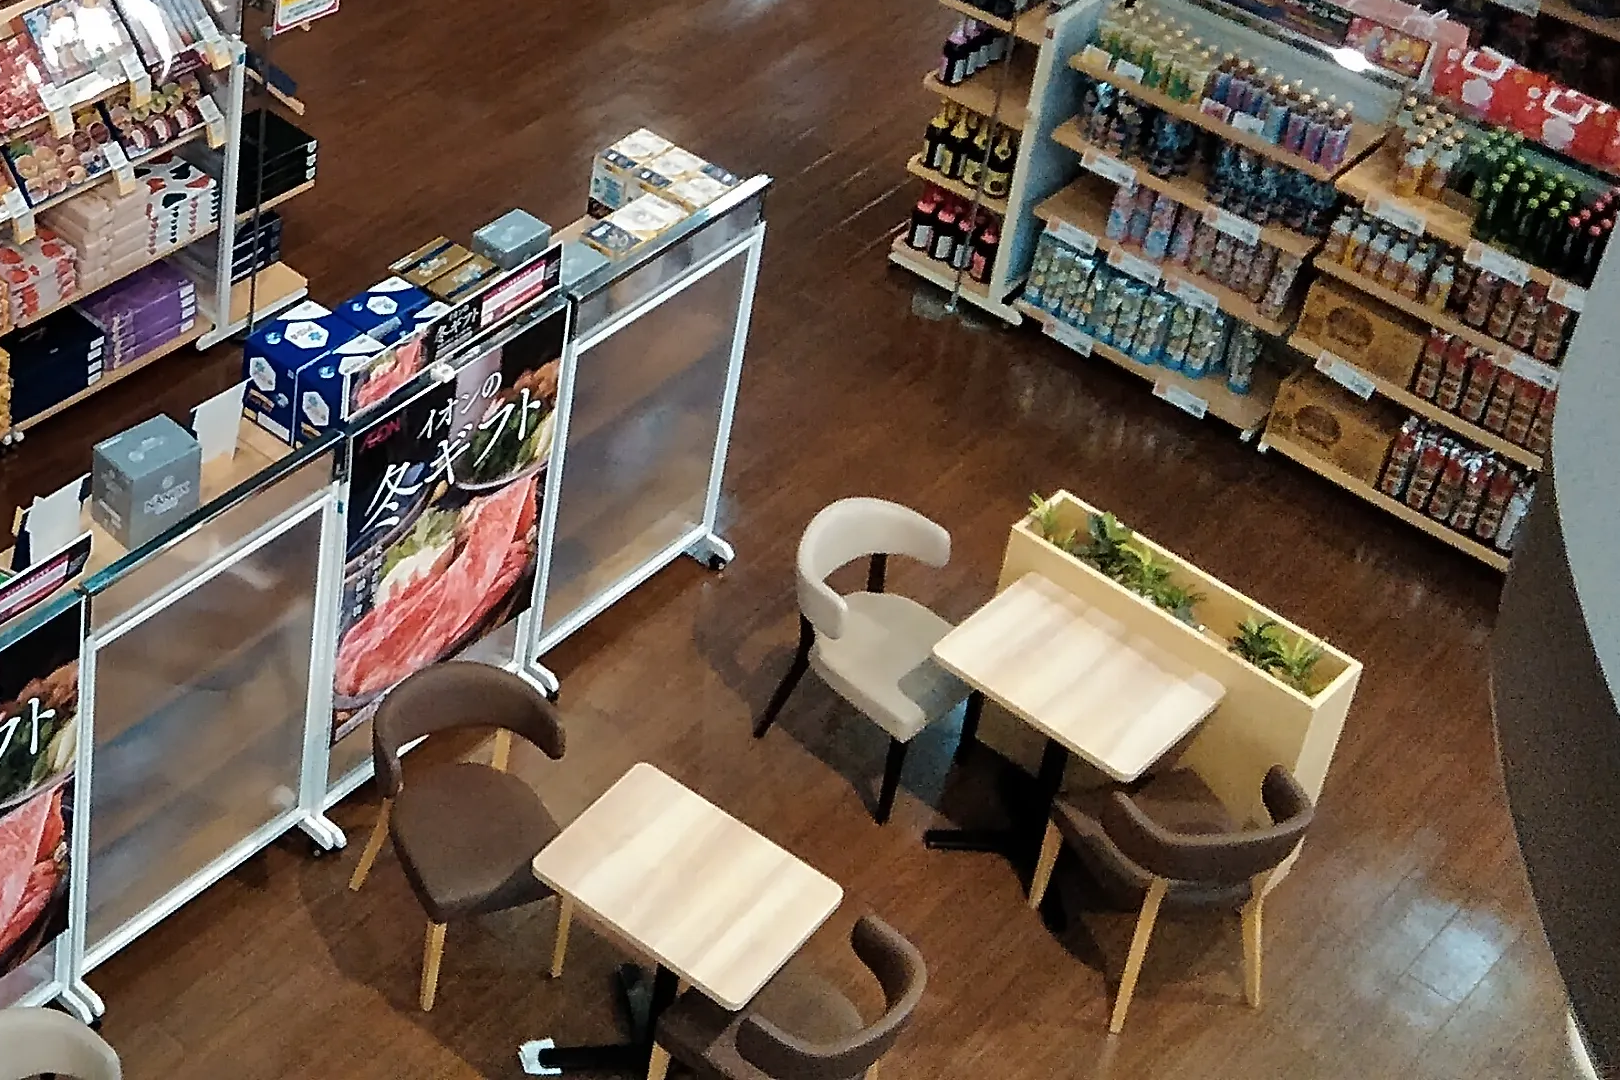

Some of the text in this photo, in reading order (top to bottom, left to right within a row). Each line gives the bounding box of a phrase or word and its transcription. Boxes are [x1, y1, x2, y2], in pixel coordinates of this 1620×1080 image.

[434, 308, 479, 344] 冬ギフト
[416, 371, 502, 440] イオンの
[359, 387, 542, 533] 冬ギフト
